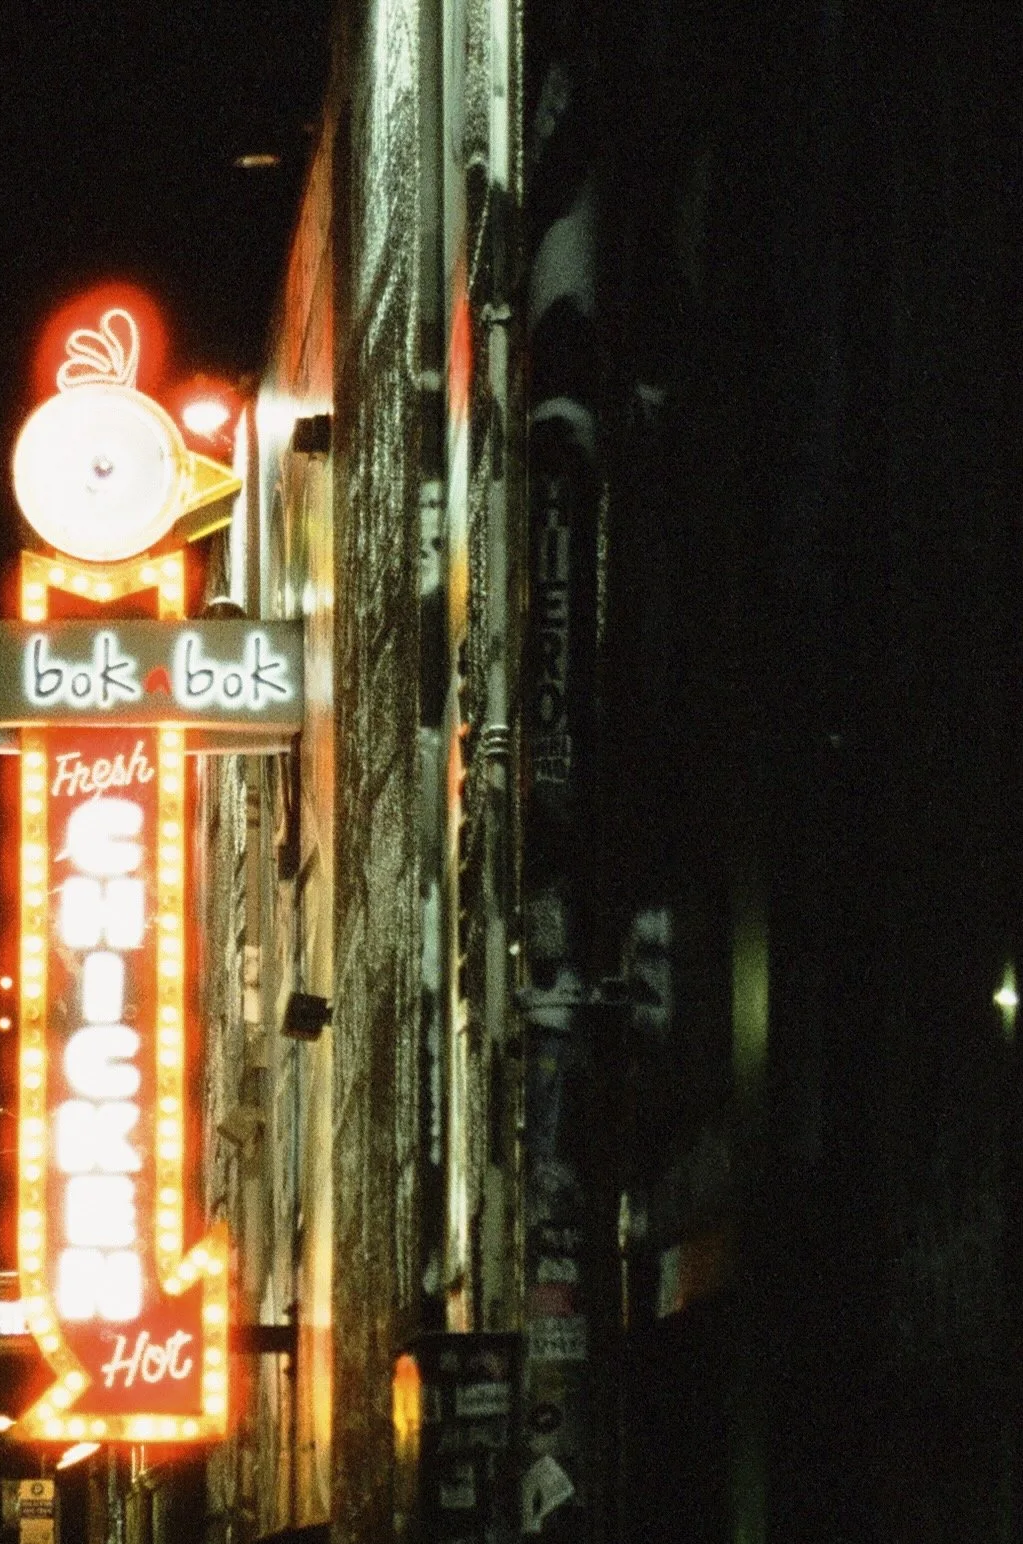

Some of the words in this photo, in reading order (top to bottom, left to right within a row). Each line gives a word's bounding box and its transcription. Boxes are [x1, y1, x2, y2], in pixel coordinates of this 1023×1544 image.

[25, 633, 139, 705] bok
[179, 633, 290, 705] bok
[51, 741, 155, 796] Fresh
[57, 798, 144, 1321] CHICKEN
[101, 1329, 193, 1388] Hot
